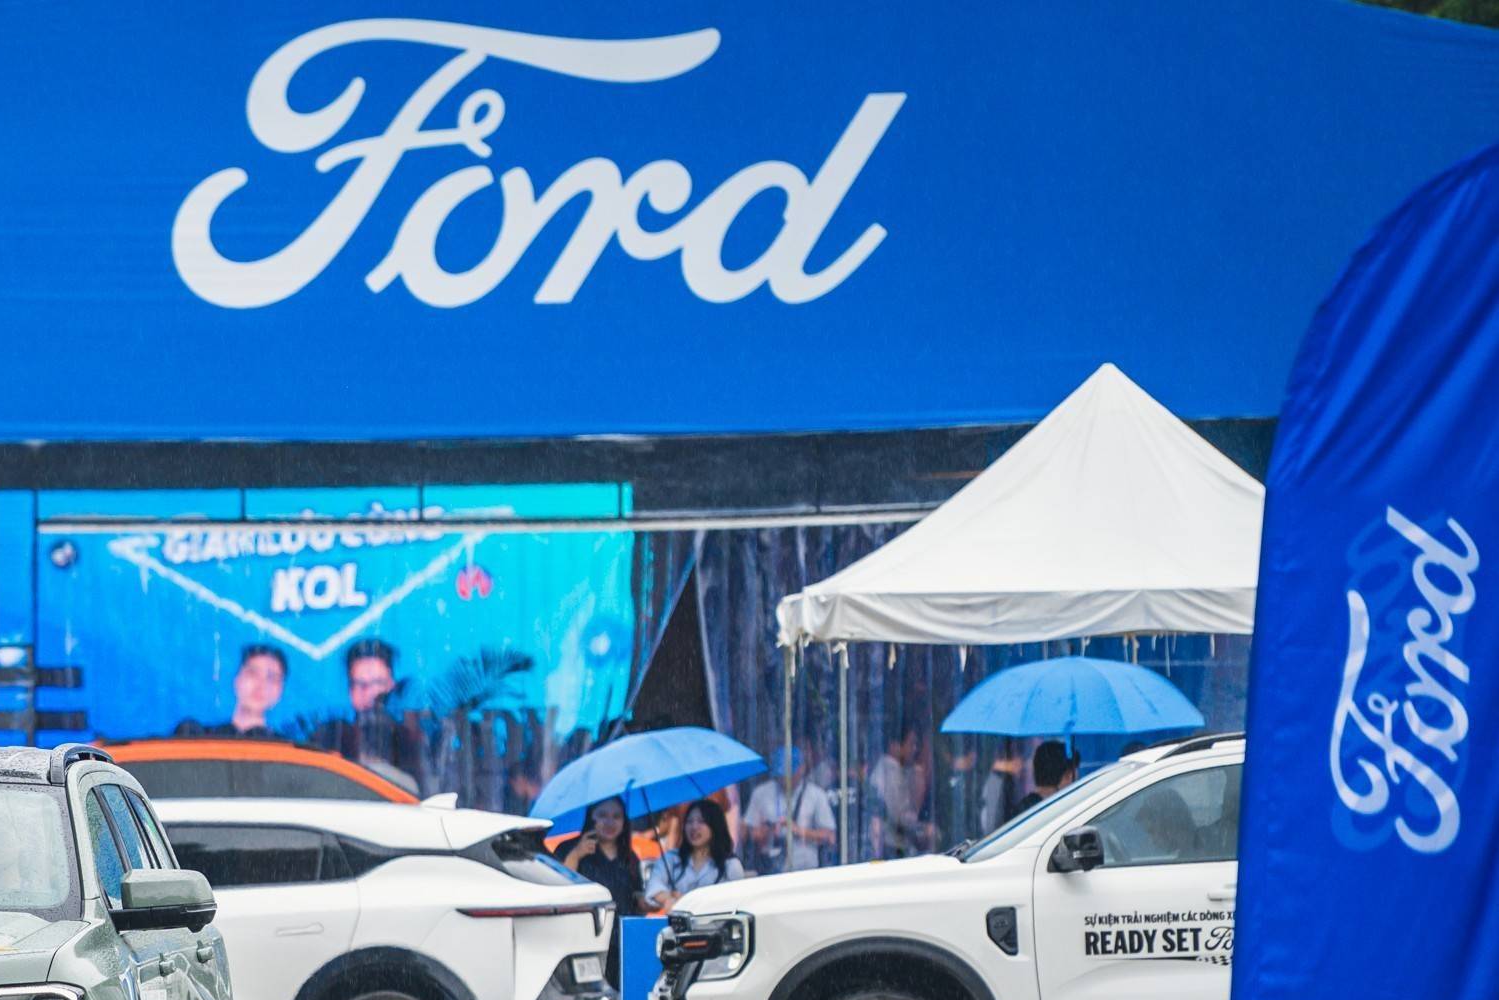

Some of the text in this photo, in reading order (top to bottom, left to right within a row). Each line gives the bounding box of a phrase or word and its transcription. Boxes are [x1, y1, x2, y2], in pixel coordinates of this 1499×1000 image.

[171, 18, 907, 309] Ford
[271, 562, 367, 611] KOL
[1330, 505, 1480, 853] Ford
[1084, 913, 1098, 928] SỰ
[1099, 913, 1120, 927] KIỆN
[1144, 911, 1180, 925] NGHIỆM
[1181, 910, 1198, 922] CÁC
[1085, 926, 1235, 956] READY SET Fo
